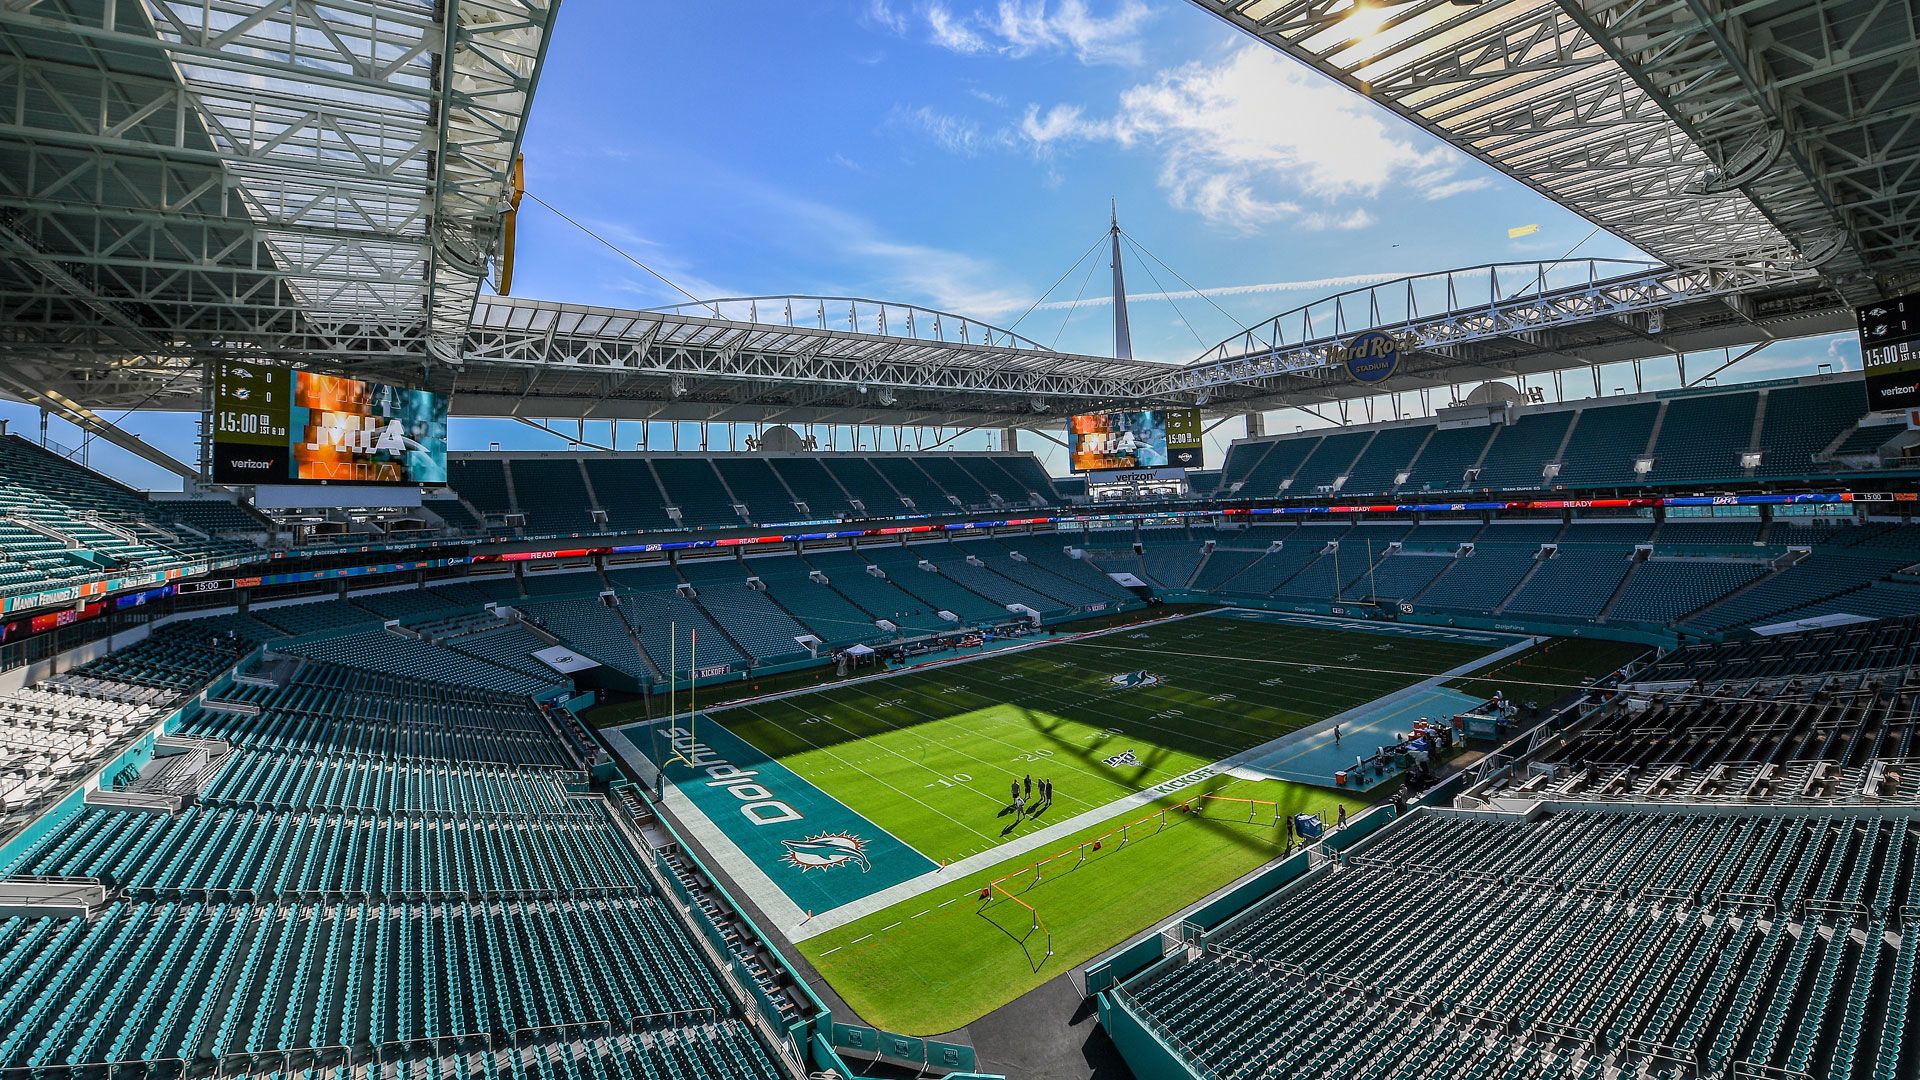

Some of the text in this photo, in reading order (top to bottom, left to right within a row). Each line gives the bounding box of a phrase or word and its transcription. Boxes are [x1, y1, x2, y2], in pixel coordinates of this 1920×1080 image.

[1898, 302, 1905, 313] 0
[1901, 320, 1908, 331] 0
[1325, 331, 1418, 364] Hard Rock
[1865, 345, 1899, 367] 15:00
[1355, 362, 1389, 373] STADIUM
[266, 372, 273, 384] 0
[266, 391, 273, 403] 0
[1880, 386, 1916, 397] verizon
[218, 411, 258, 434] 15:00
[259, 425, 271, 435] 1ST
[278, 427, 286, 436] 10
[306, 411, 407, 456] MIA
[1167, 433, 1187, 445] 15:00
[230, 458, 270, 470] verizon
[1115, 472, 1154, 482] verizon
[1563, 500, 1593, 508] READY
[738, 537, 760, 545] READY
[530, 551, 558, 559] READY
[195, 582, 218, 592] 15:00
[12, 595, 39, 612] MANNY
[39, 588, 72, 606] FERNANDEZ
[56, 609, 78, 626] READY
[1494, 623, 1525, 632] Dolphins
[700, 667, 727, 678] KICKOFF
[1018, 749, 1054, 763] 20
[657, 726, 804, 826] Dolphins
[935, 773, 973, 788] 10
[1153, 766, 1217, 796] KICKOFF
